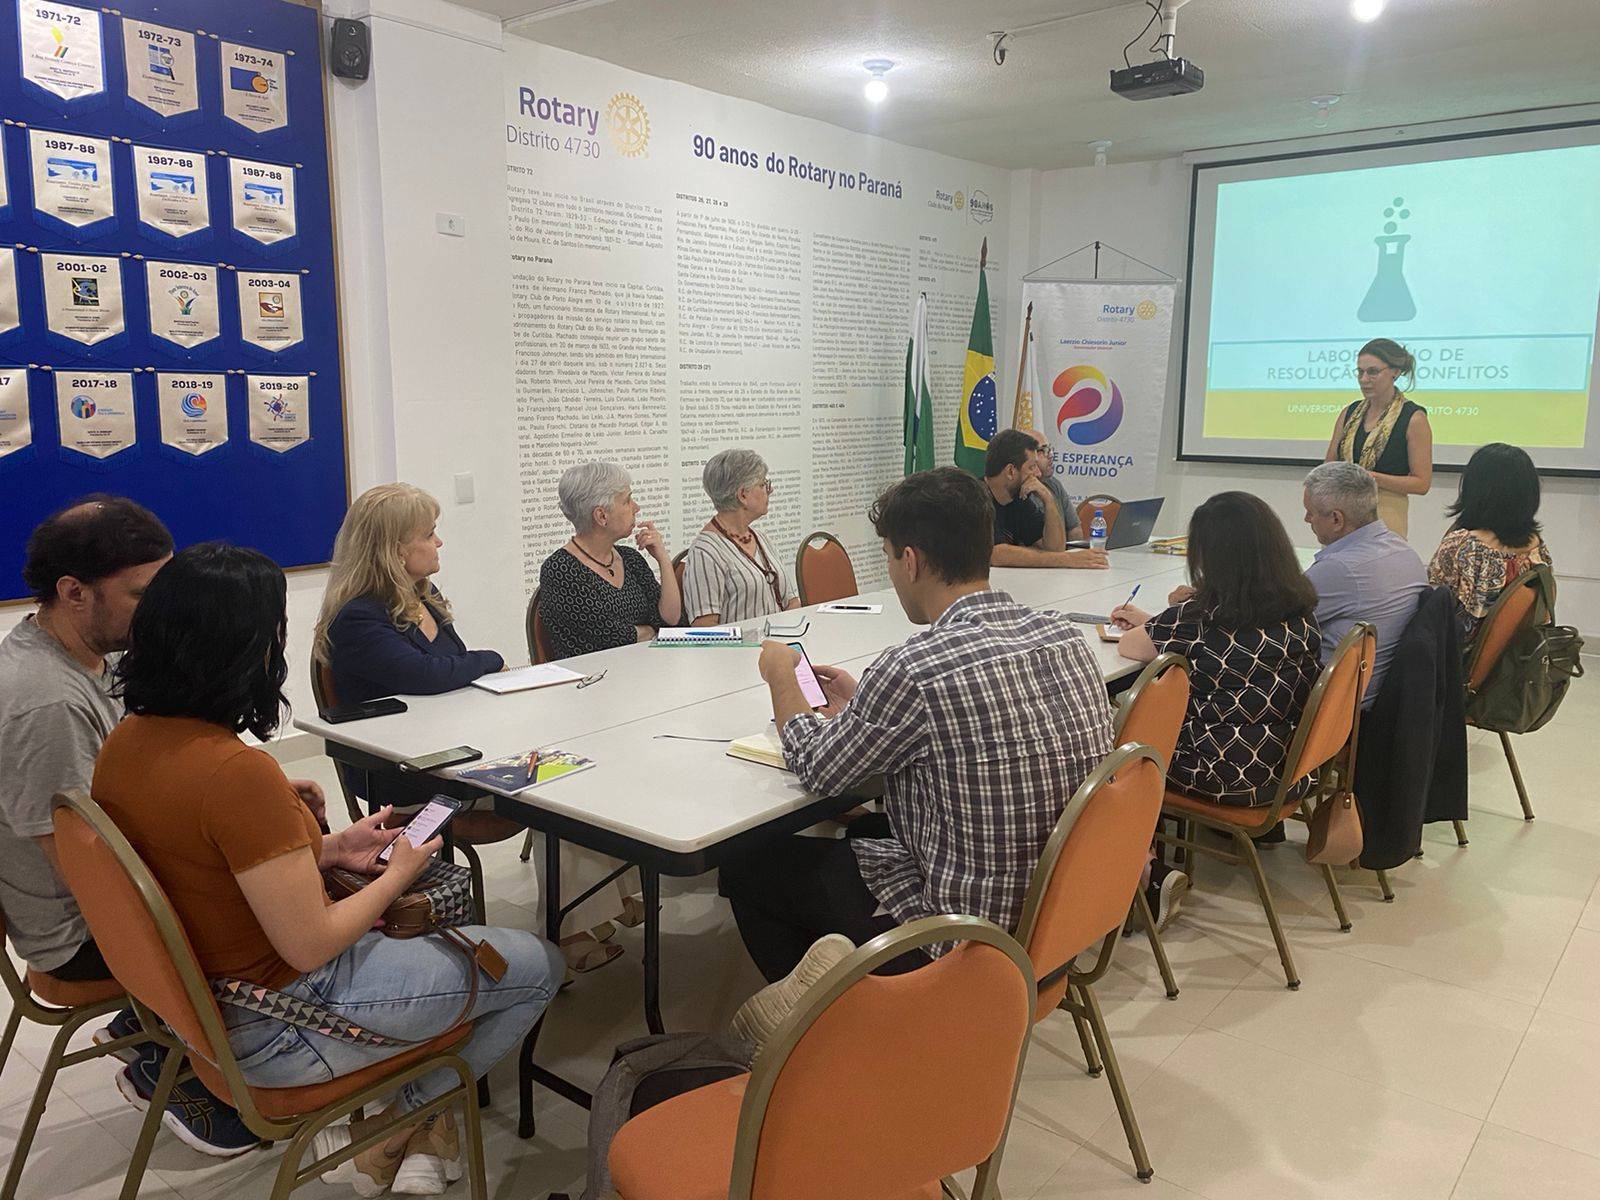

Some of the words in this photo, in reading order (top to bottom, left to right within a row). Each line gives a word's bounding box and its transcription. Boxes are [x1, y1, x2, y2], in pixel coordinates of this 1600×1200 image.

[36, 9, 81, 26] 1971-72
[138, 29, 181, 47] 1972-73
[234, 52, 273, 67] 1973-74
[519, 86, 599, 135] Rotary
[45, 139, 96, 154] 1987-88
[506, 124, 560, 151] Distrito
[564, 136, 600, 159] 4730
[148, 155, 193, 168] 1987-88
[693, 134, 715, 159] 90
[719, 145, 758, 169] anos
[766, 152, 784, 174] do
[788, 156, 836, 189] Rotary
[839, 171, 855, 189] no
[858, 171, 902, 199] Paraná
[243, 167, 282, 180] 1987-88
[511, 254, 526, 262] otary
[535, 255, 553, 264] Paraná
[57, 262, 107, 273] 2001-02
[160, 269, 207, 281] 2002-03
[546, 275, 563, 285] Rotary
[248, 279, 290, 288] 2003-04
[604, 307, 620, 316] Rotary
[1102, 304, 1135, 316] Rotary
[557, 323, 573, 332] Rotary
[1440, 348, 1464, 361] DE
[72, 379, 117, 388] 2017-18
[172, 380, 213, 390] 2018-19
[259, 382, 299, 391] 2019-20
[1062, 453, 1134, 468] ESPERANÇA
[1068, 465, 1118, 477] MUNDO
